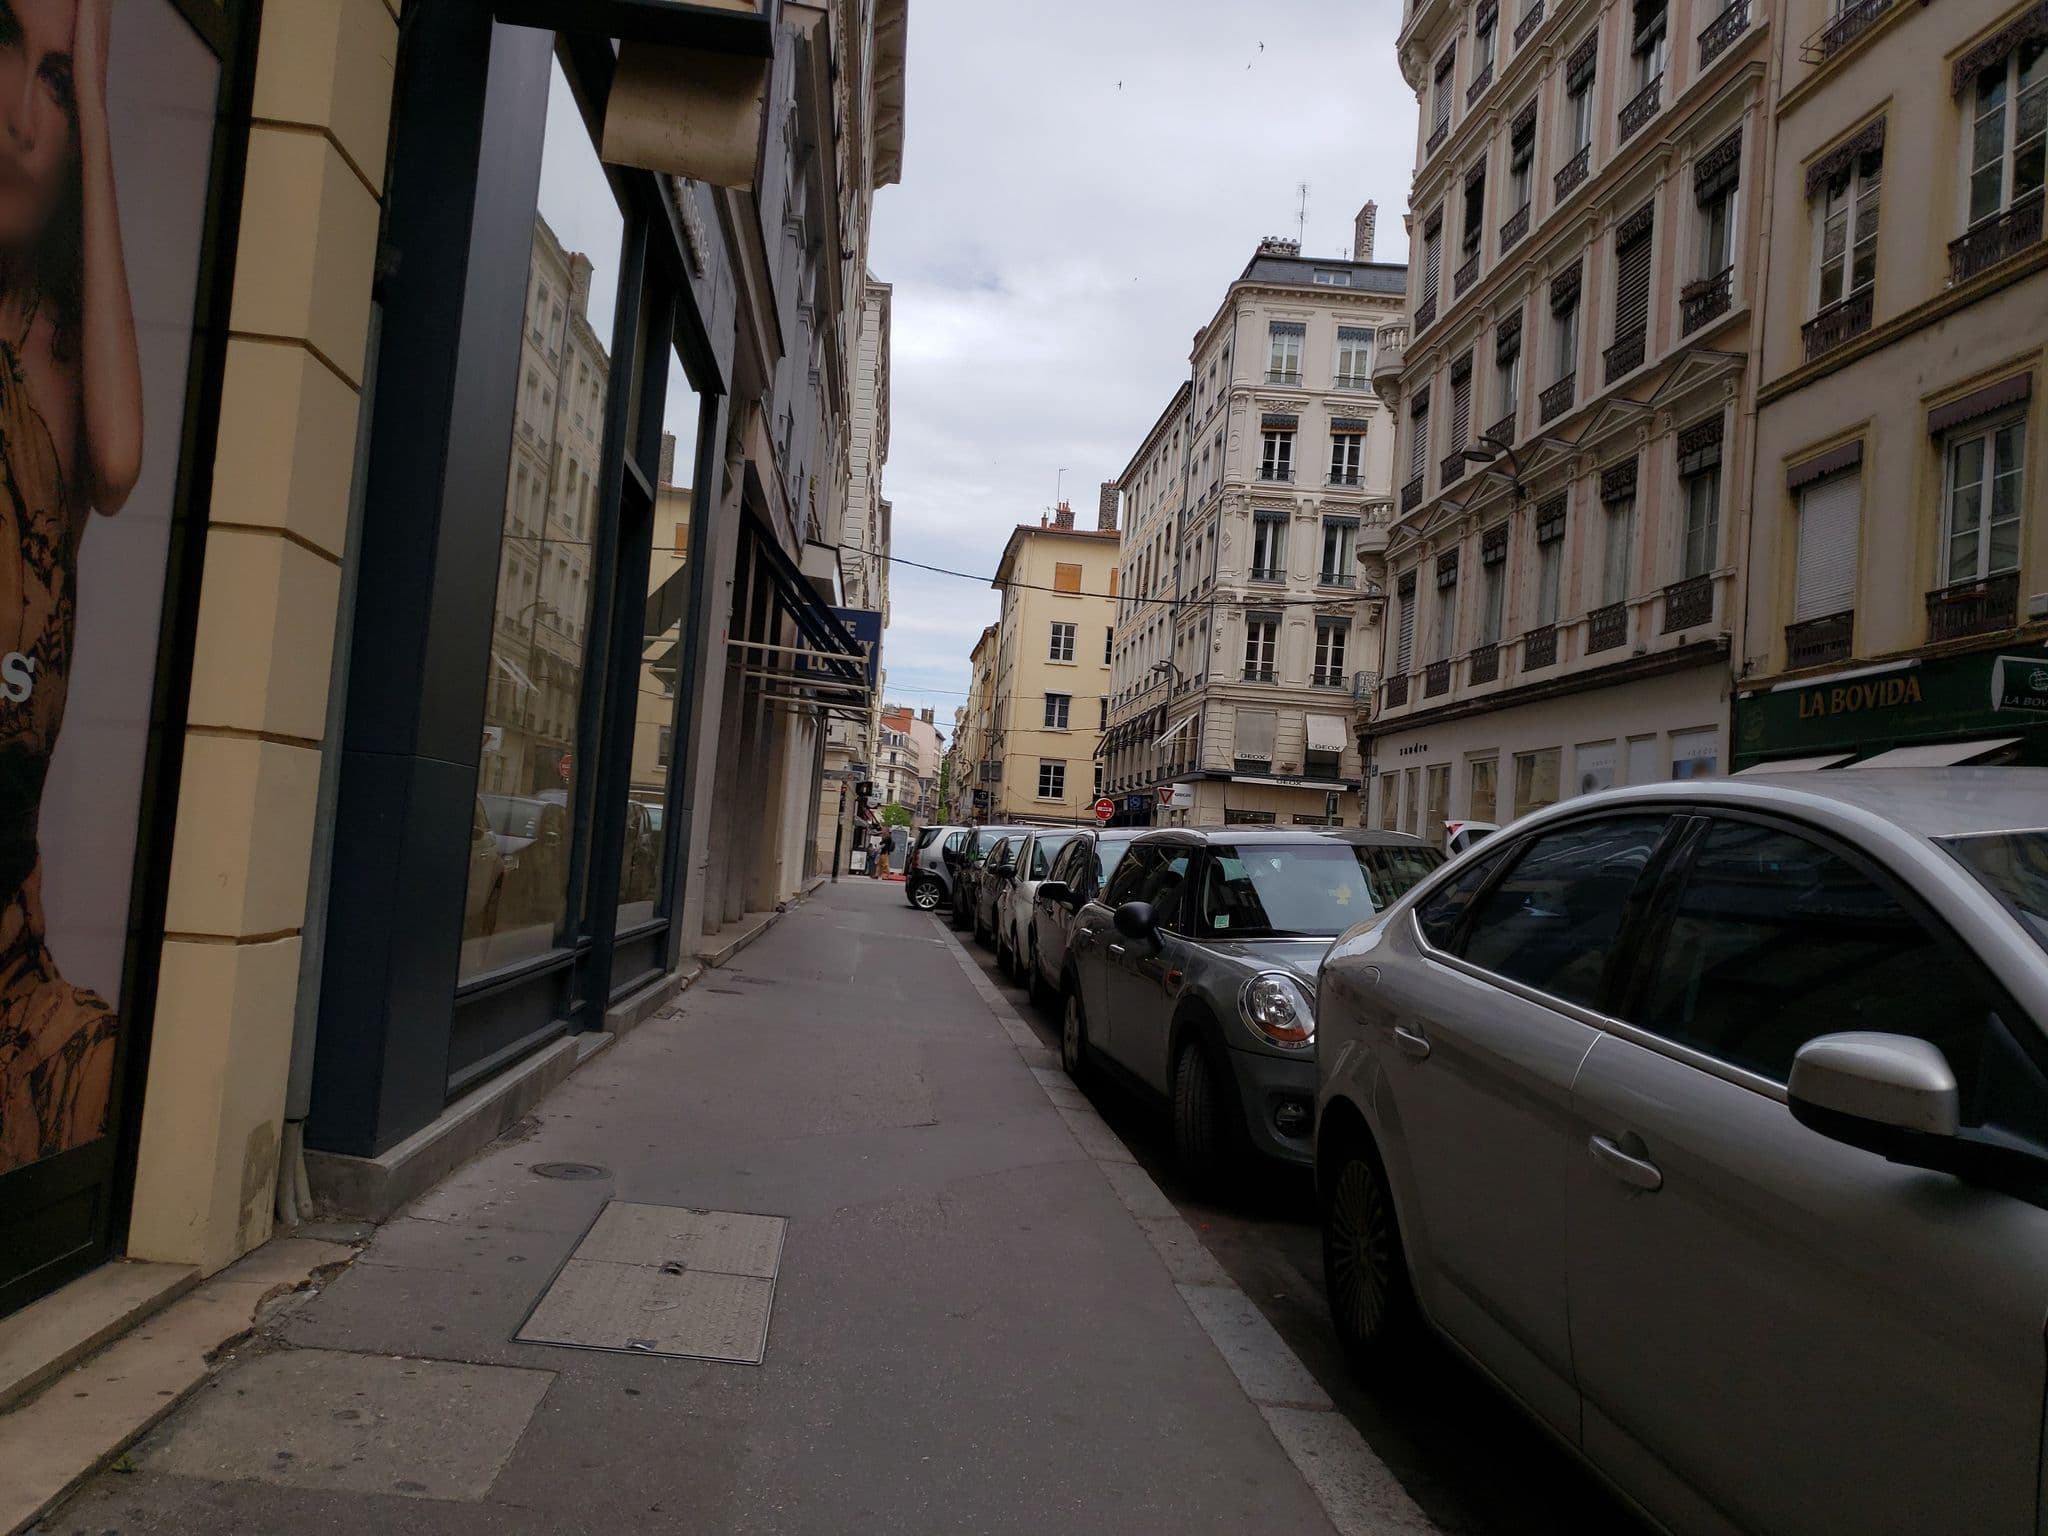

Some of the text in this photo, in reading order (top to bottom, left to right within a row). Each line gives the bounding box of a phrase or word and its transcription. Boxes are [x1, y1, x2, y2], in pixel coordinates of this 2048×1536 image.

[1799, 673, 1922, 718] LA BOVIDA
[2004, 695, 2019, 705] LA
[1314, 743, 1340, 751] GEOX
